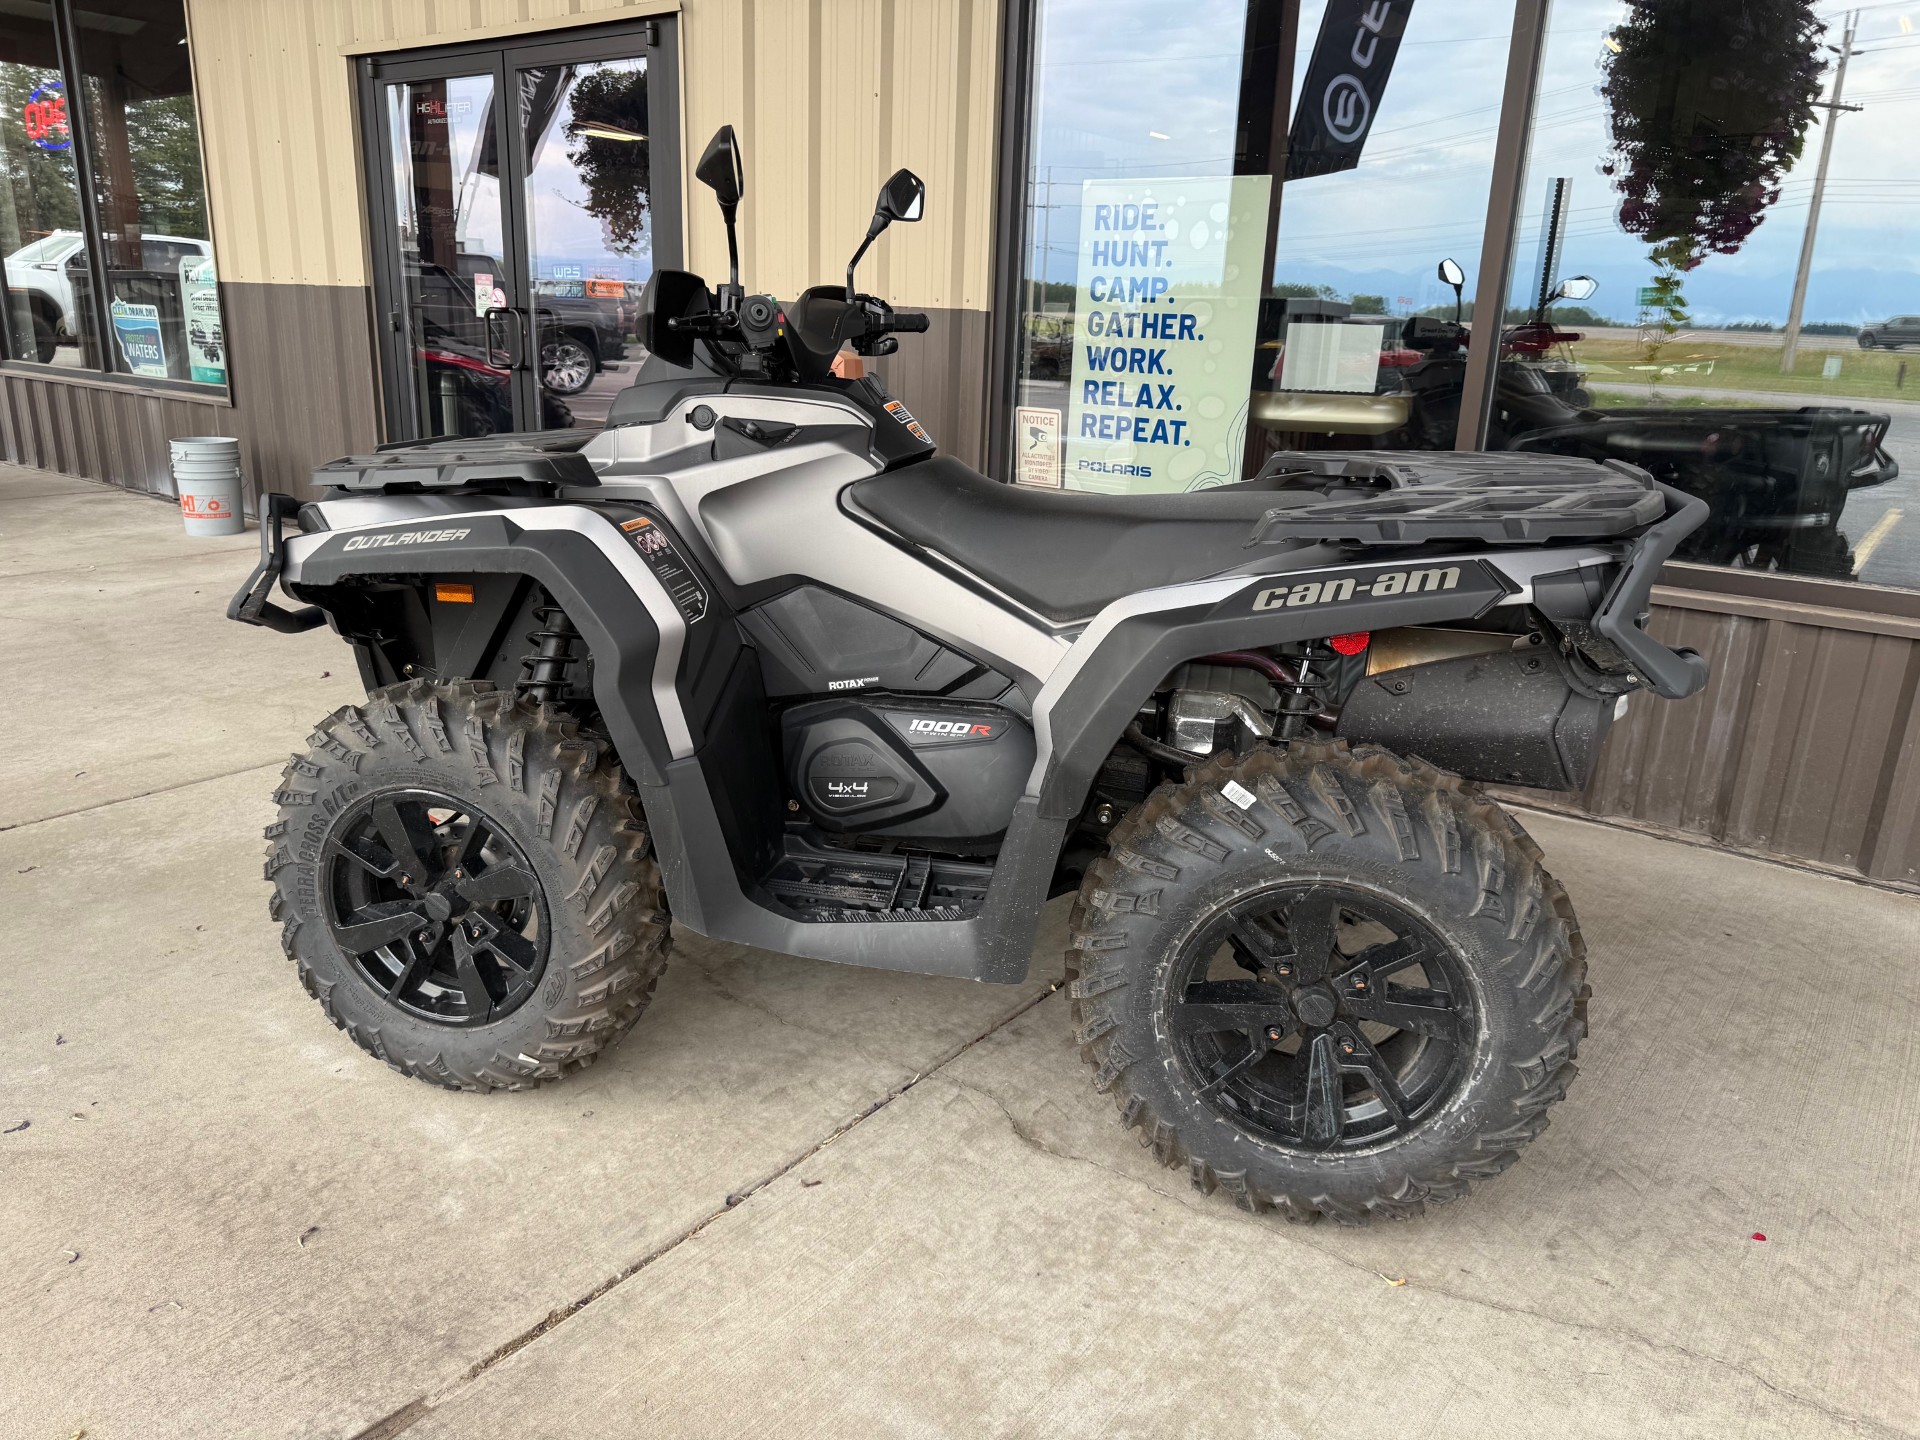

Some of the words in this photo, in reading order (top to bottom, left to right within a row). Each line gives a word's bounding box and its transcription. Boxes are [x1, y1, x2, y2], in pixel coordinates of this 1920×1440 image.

[24, 97, 69, 139] OPE
[1094, 203, 1165, 231] RIDE.
[1091, 239, 1173, 268] HUNT.
[553, 266, 581, 278] WPS
[1089, 275, 1175, 304] CAMP.
[125, 333, 145, 343] PROTECT
[1087, 311, 1204, 342] GATHER.
[126, 342, 159, 360] WATERS
[1086, 345, 1173, 375] WORK.
[1083, 380, 1182, 411] RELAX.
[1022, 414, 1055, 426] NOTICE
[1081, 412, 1191, 446] REPEAT.
[1078, 459, 1152, 477] POLARIS
[342, 527, 471, 551] OUTLANDER
[1252, 567, 1460, 612] can-am
[828, 677, 865, 690] ROTAX
[909, 719, 991, 736] 1000R
[827, 781, 869, 794] 4x4
